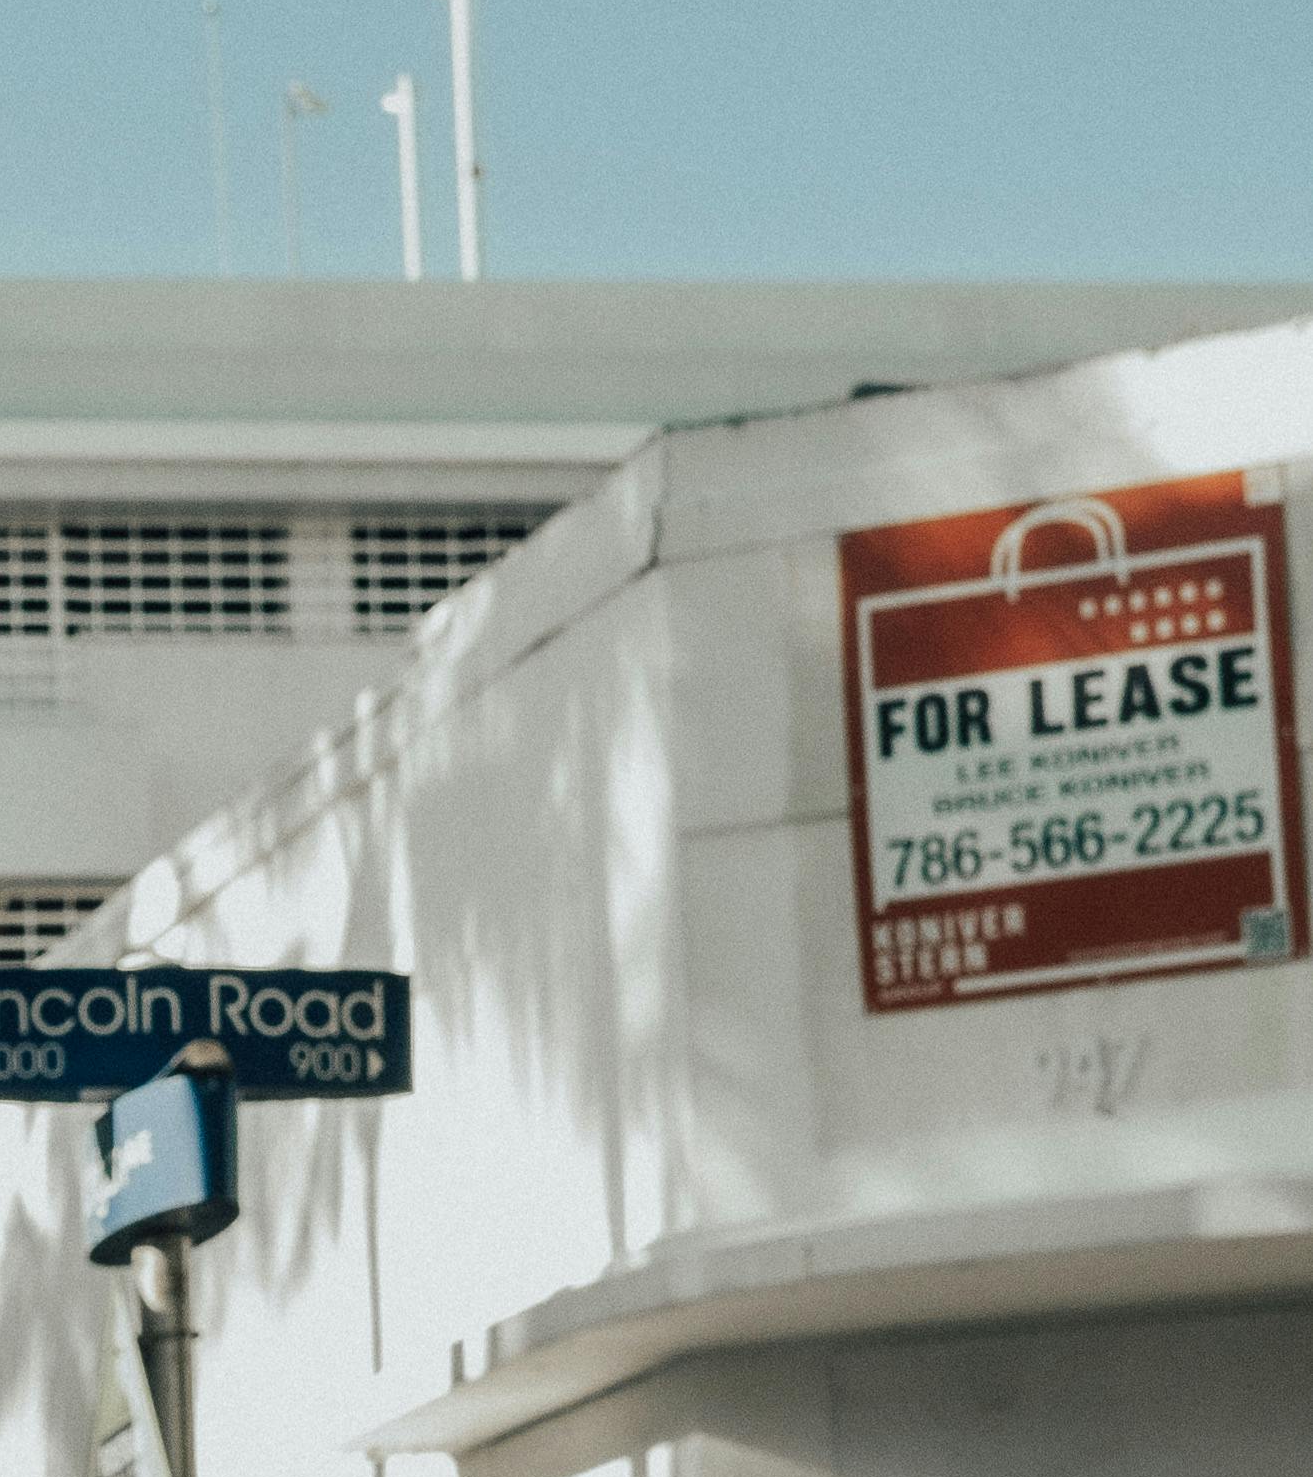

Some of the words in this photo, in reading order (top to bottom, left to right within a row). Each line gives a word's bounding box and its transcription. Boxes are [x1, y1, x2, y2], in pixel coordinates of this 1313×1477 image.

[877, 688, 992, 759] FOR
[1028, 646, 1259, 737] LEASE
[888, 788, 1265, 889] 786-566-2225
[208, 975, 385, 1040] Road
[288, 1042, 362, 1081] 900
